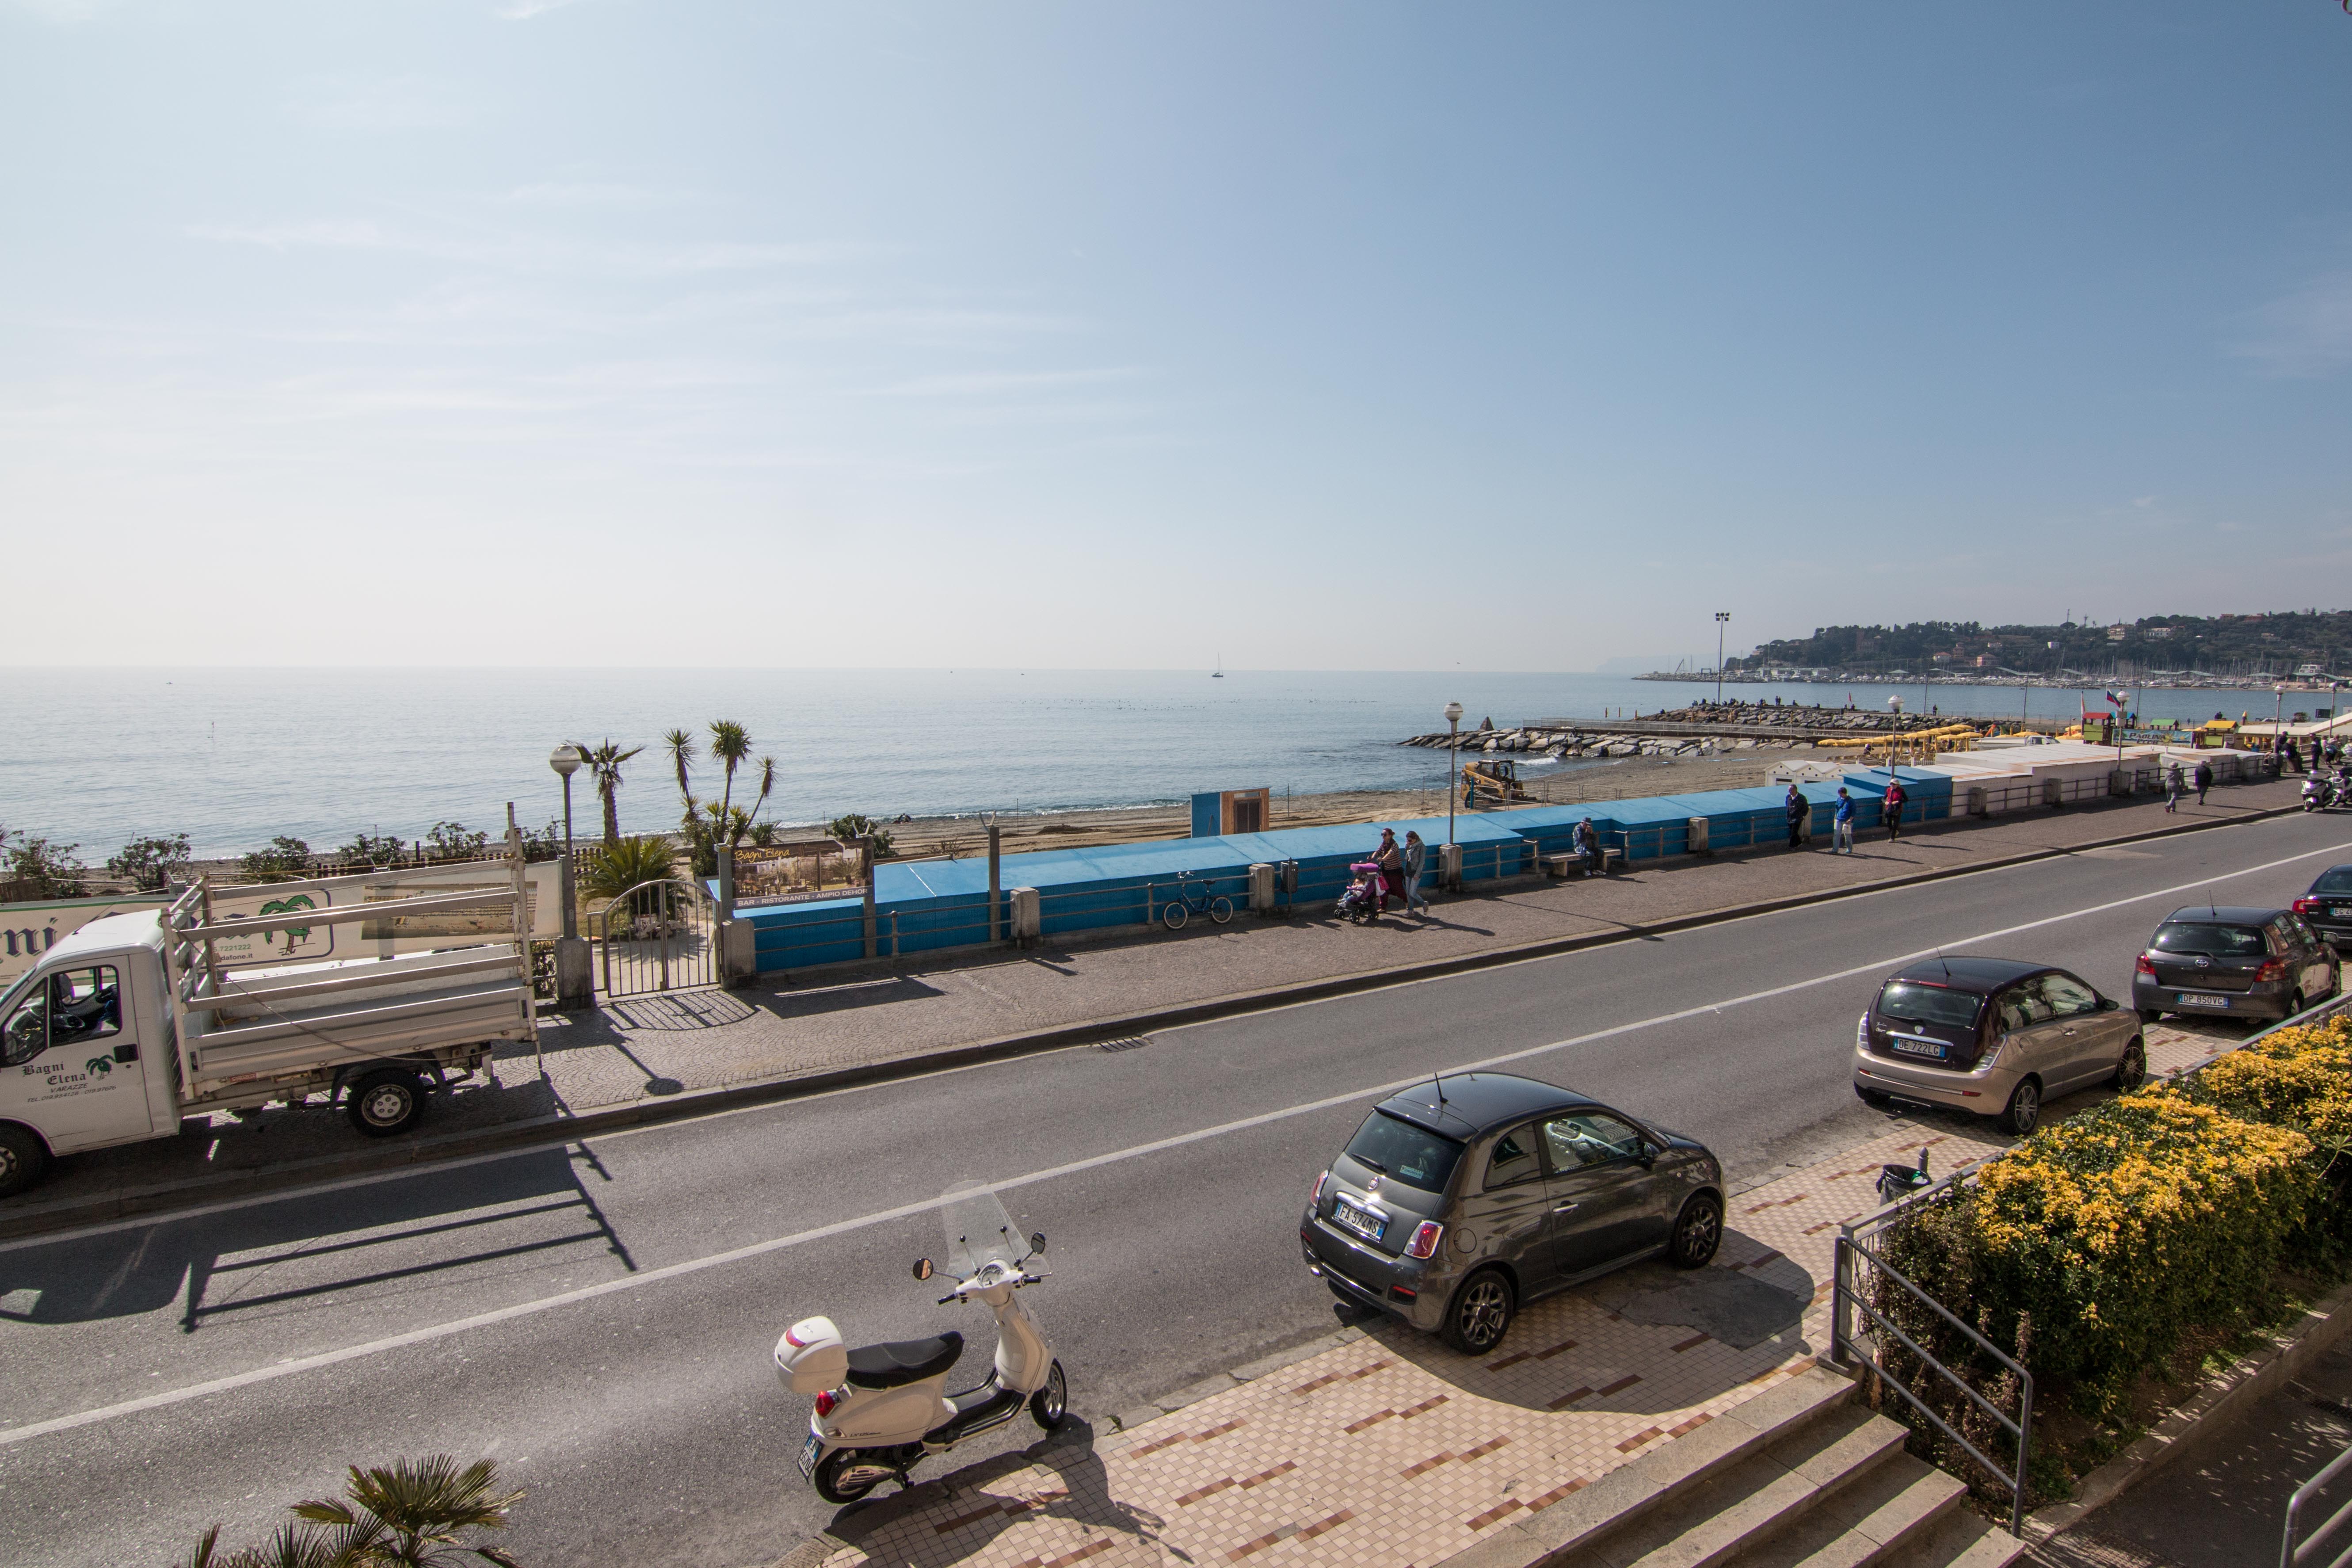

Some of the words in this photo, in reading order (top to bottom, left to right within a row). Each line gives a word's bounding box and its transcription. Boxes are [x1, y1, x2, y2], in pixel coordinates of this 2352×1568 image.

[734, 850, 762, 862] Bagni
[764, 848, 790, 858] Elena
[762, 894, 810, 904] RISTORANTE
[1898, 1039, 1909, 1049] DE
[1912, 1042, 1939, 1055] 722LG
[22, 1061, 65, 1076] Bagni
[47, 1073, 87, 1085] Elena
[50, 1083, 88, 1093] VARAZZE
[1340, 1205, 1351, 1219] FA
